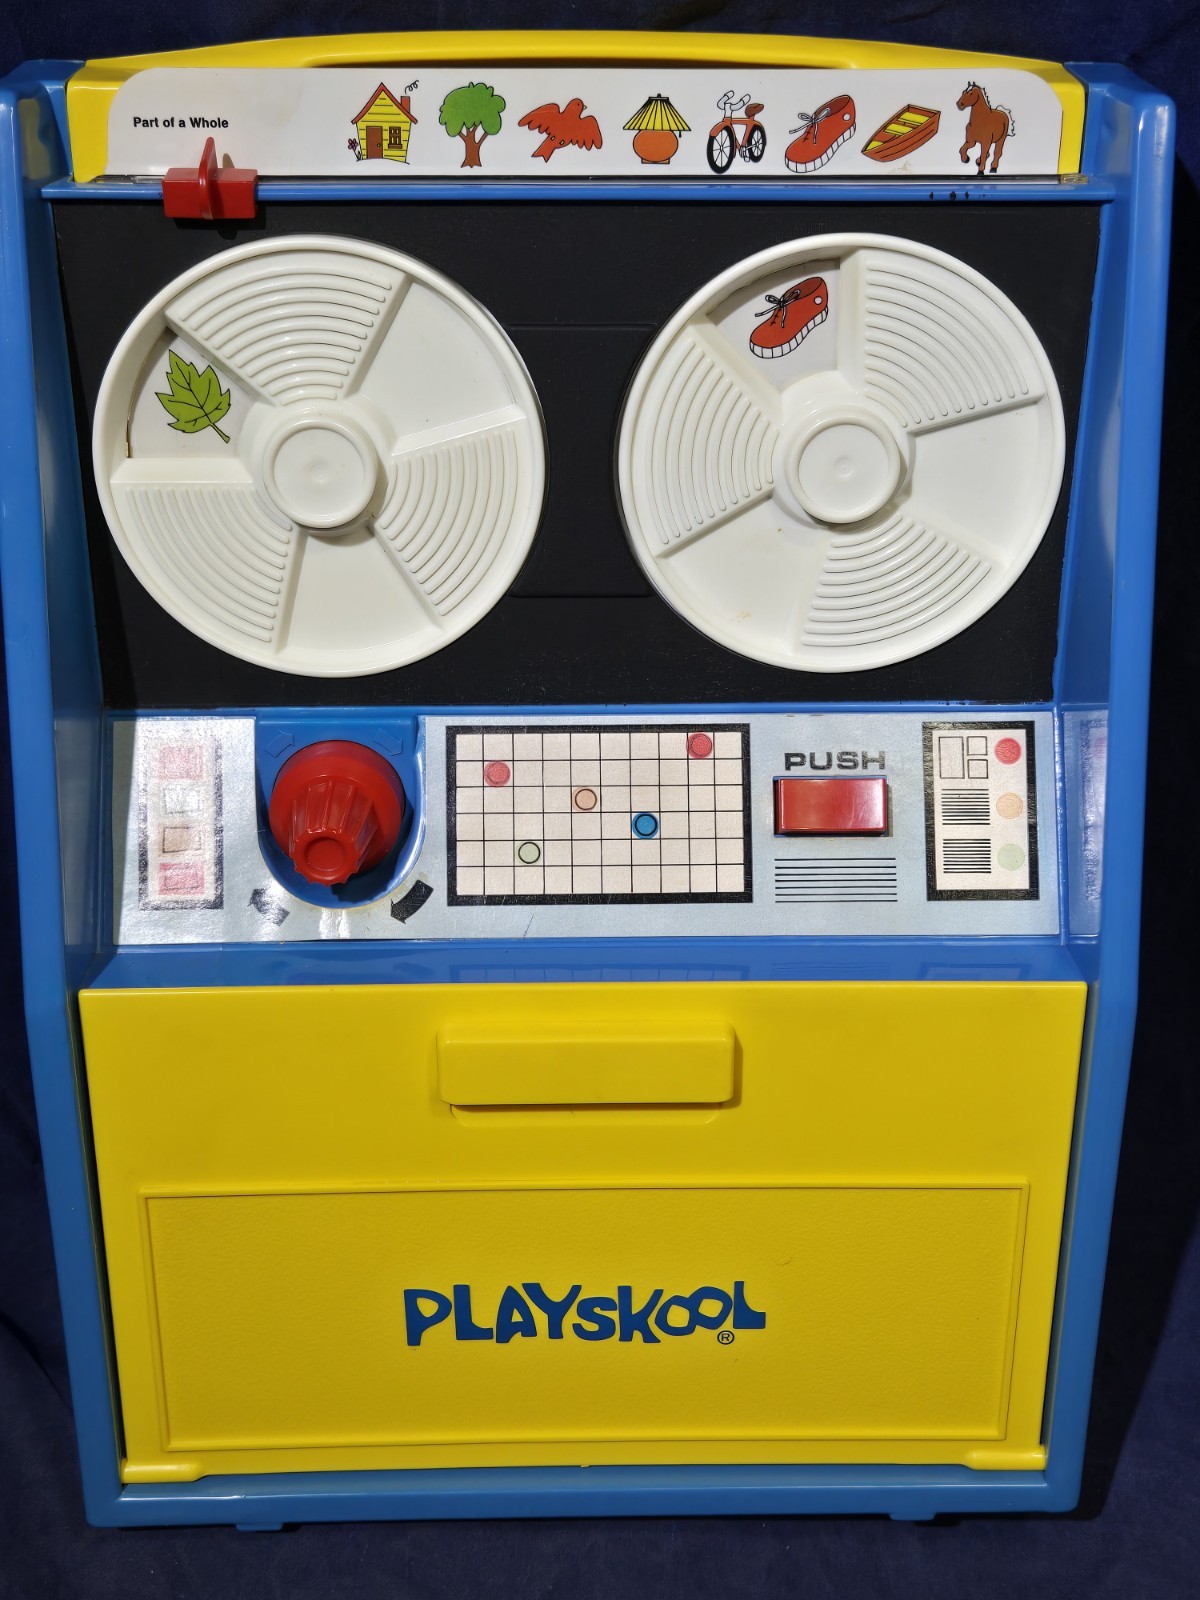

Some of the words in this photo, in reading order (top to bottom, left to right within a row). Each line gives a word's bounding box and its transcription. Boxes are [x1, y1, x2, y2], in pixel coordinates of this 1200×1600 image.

[133, 116, 159, 128] Part
[162, 116, 175, 128] of
[178, 119, 186, 128] a
[189, 117, 229, 129] Whole
[783, 751, 886, 772] PUSH
[403, 1280, 766, 1347] PLAYSKOOL
